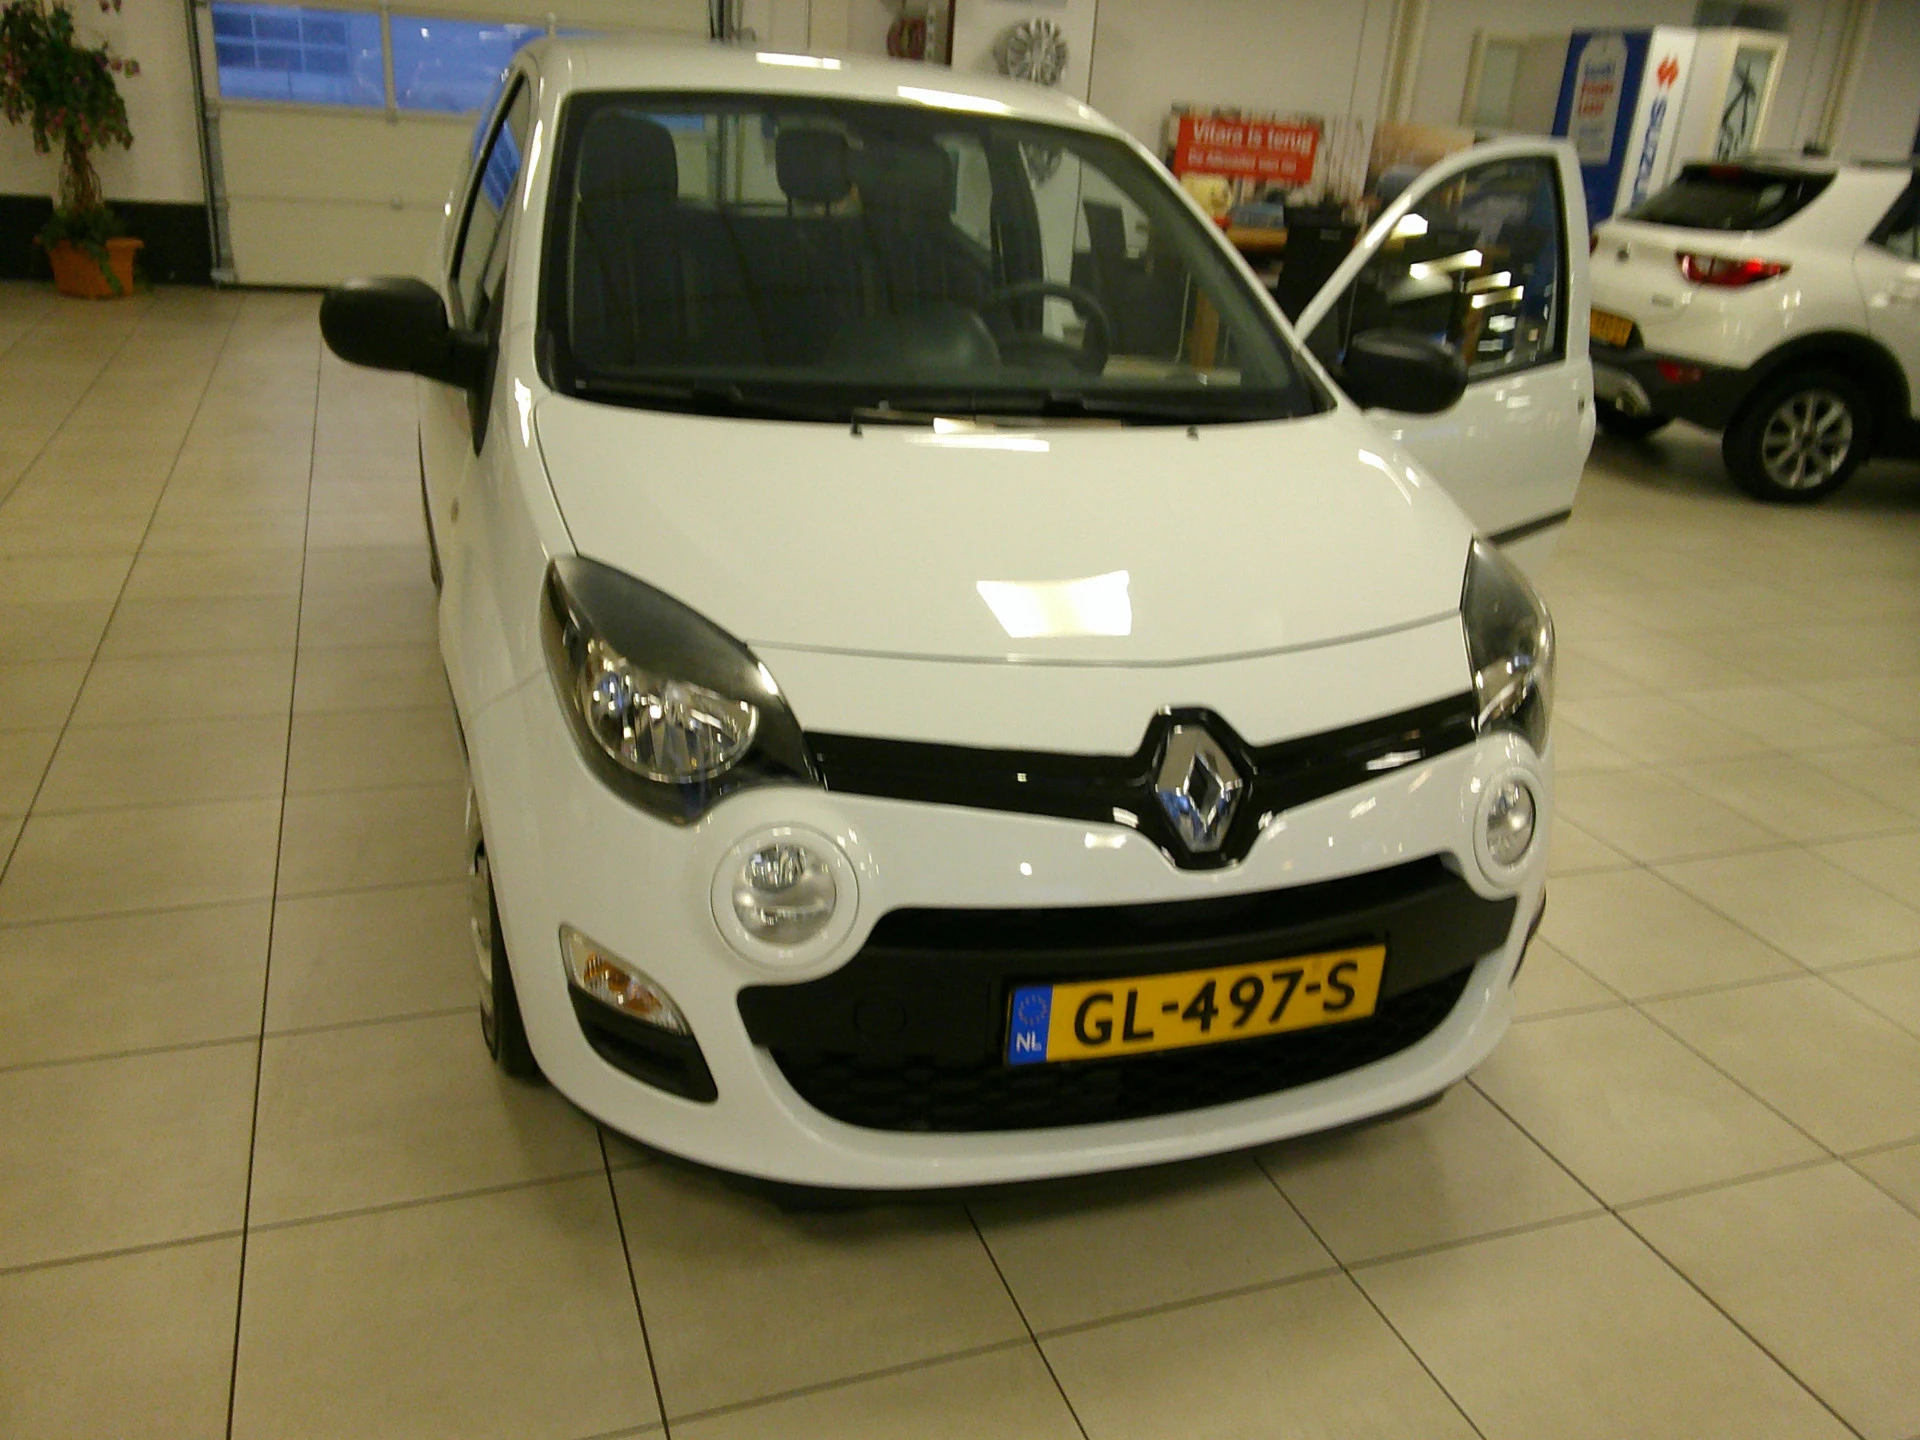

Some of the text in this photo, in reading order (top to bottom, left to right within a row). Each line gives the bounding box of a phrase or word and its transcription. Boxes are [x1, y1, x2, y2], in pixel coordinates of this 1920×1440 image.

[1193, 119, 1243, 147] Vitara
[1247, 124, 1262, 149] is
[1631, 95, 1668, 209] SUZU
[1074, 961, 1358, 1046] GL-497-S
[1015, 1031, 1042, 1053] NL
